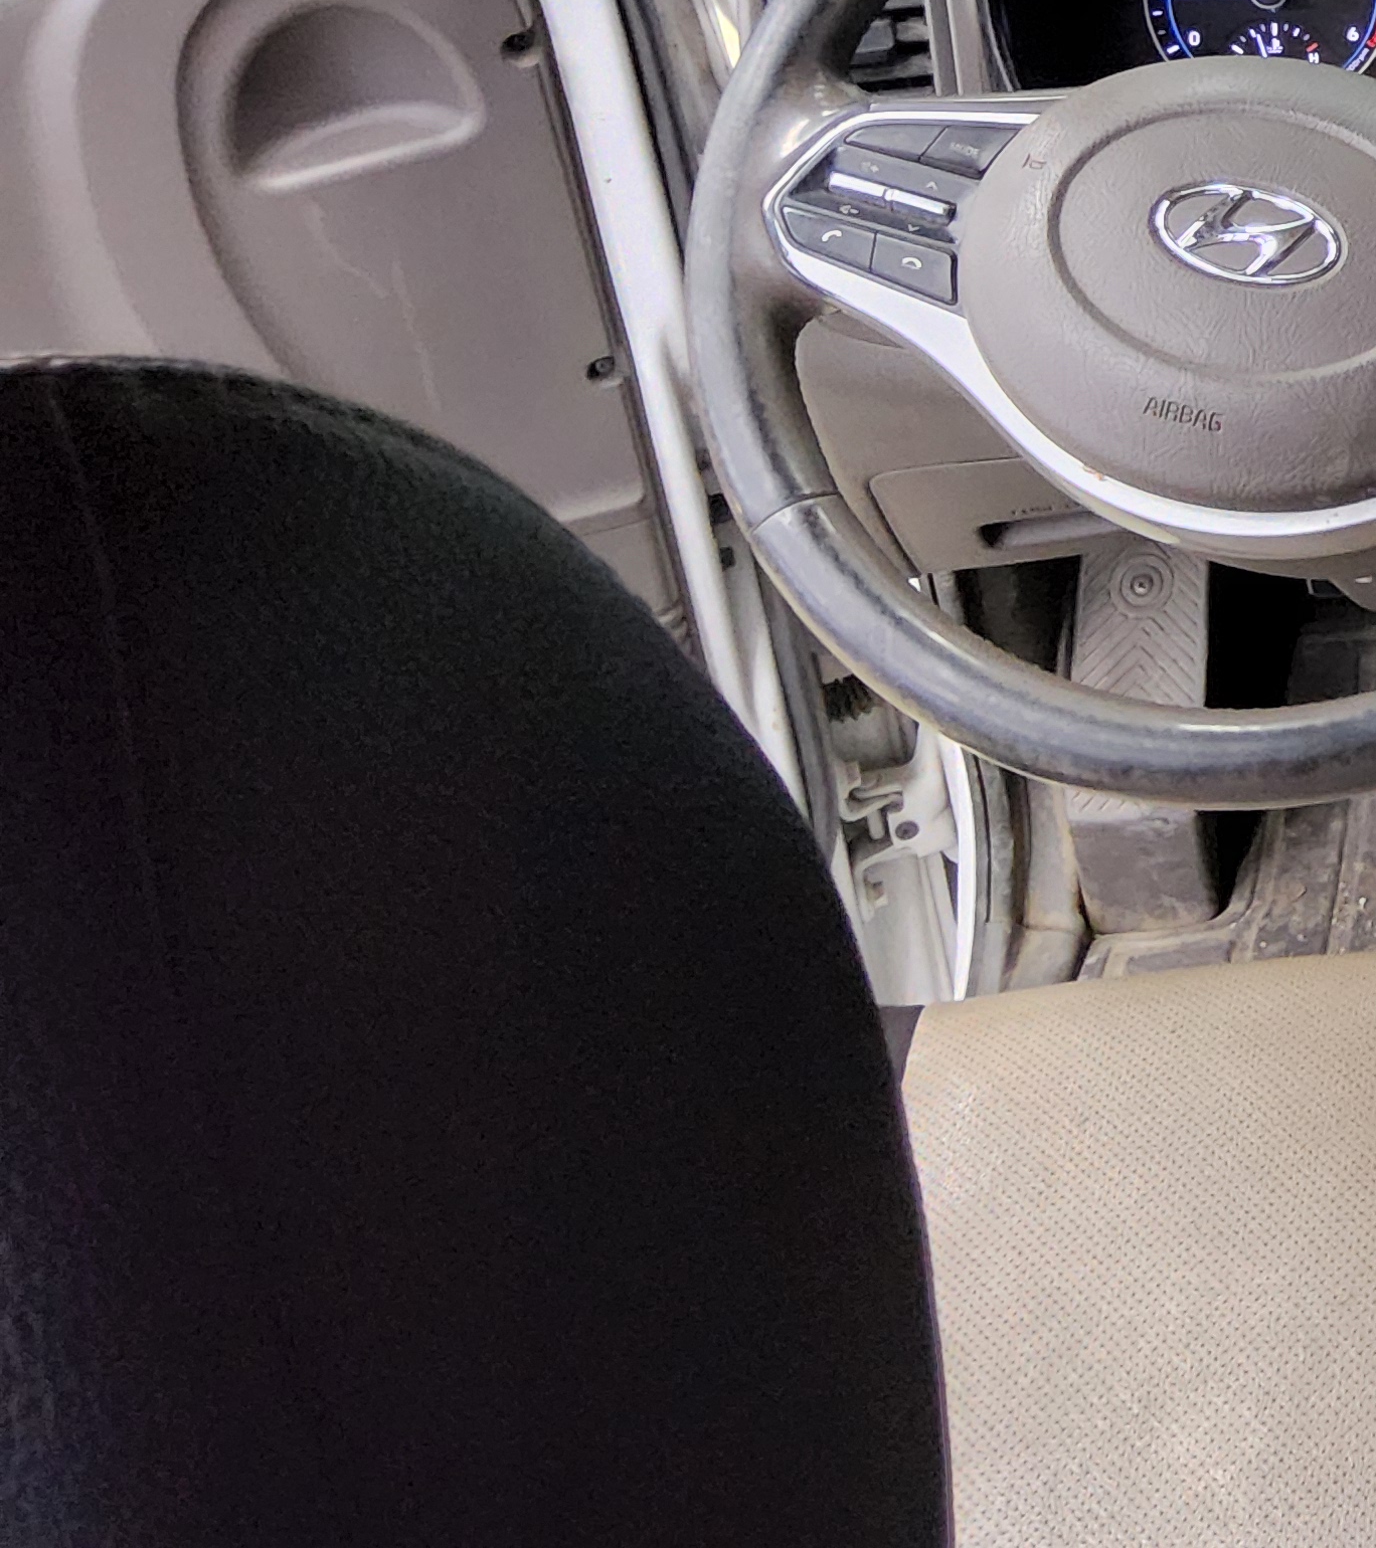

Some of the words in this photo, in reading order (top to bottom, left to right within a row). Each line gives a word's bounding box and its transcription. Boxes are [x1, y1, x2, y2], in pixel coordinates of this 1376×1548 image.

[1187, 30, 1202, 46] 0
[1346, 26, 1360, 42] 6
[1307, 52, 1320, 64] H
[1143, 396, 1225, 432] AIRBAG
